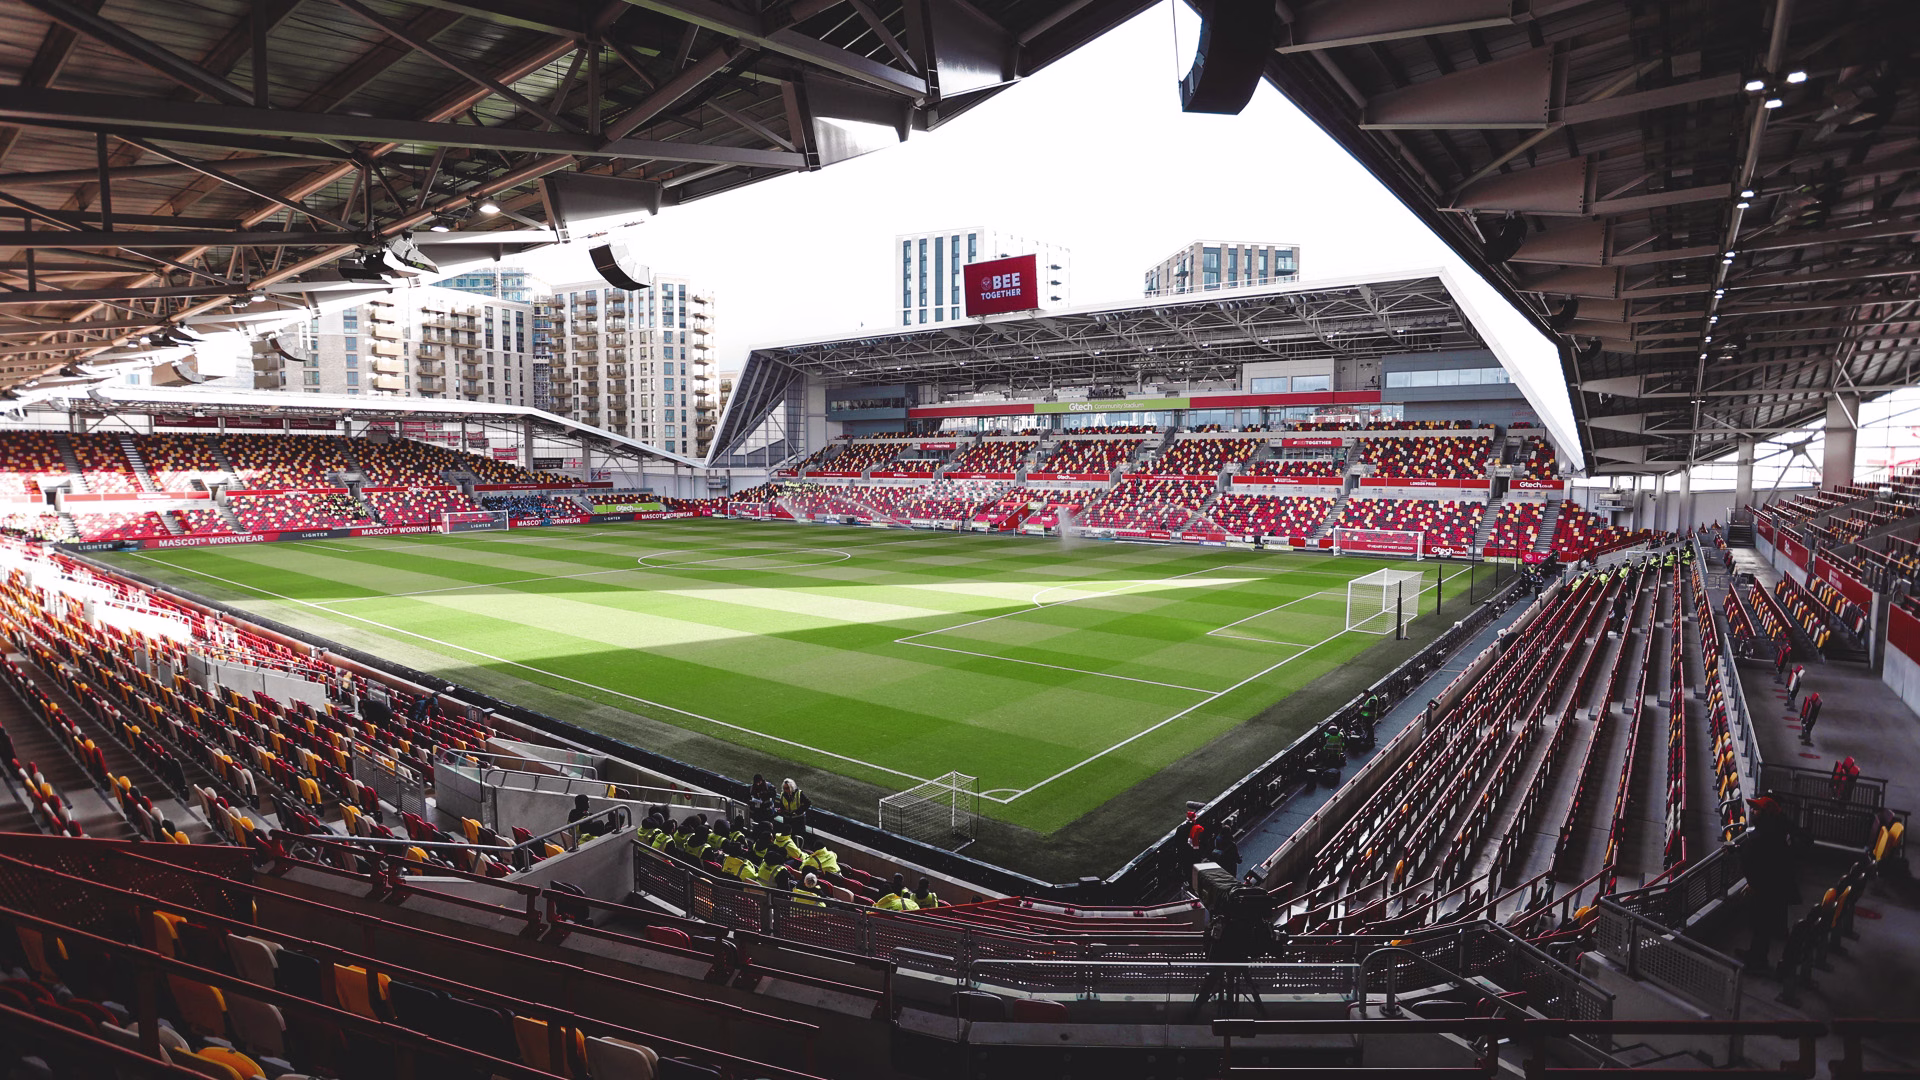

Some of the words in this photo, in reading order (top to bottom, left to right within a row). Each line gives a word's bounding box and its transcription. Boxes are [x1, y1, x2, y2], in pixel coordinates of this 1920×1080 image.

[993, 272, 1020, 290] BEE
[981, 288, 1021, 300] TOGETHER
[1069, 402, 1093, 412] Gtech
[1094, 403, 1123, 411] Community
[550, 517, 581, 525] ORKWEAR
[208, 534, 264, 545] WORKWEAR
